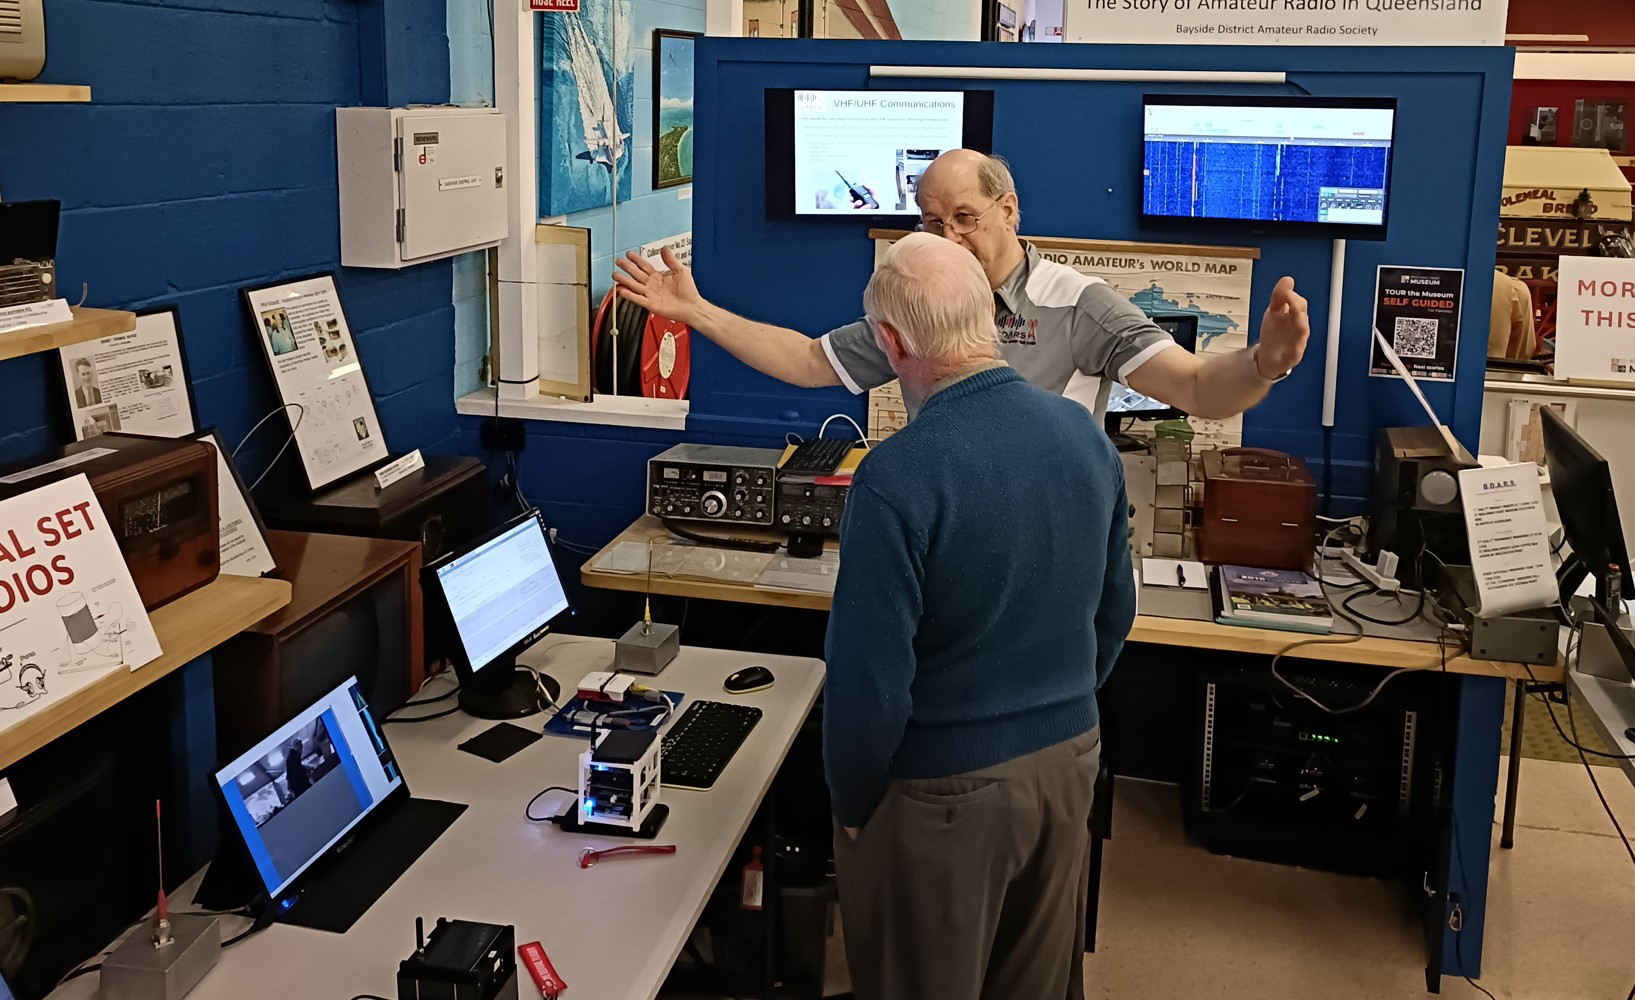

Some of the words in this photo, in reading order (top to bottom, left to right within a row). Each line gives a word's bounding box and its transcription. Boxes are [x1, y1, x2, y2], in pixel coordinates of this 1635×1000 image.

[1122, 0, 1165, 13] Story
[1174, 0, 1190, 10] of
[1197, 0, 1274, 10] Amateur
[1284, 0, 1336, 10] Radio
[1343, 0, 1359, 10] in
[1366, 0, 1482, 12] Queensland
[1176, 25, 1214, 35] Bayside
[1218, 25, 1254, 34] District
[1258, 26, 1303, 34] Amateur
[1306, 25, 1336, 34] Radio
[1339, 26, 1378, 36] Society
[880, 100, 955, 108] Communications
[1501, 189, 1557, 207] OLEMEAL
[1542, 203, 1598, 214] BRED
[1497, 226, 1614, 248] CLEVEL
[1038, 253, 1068, 264] DIO
[1072, 255, 1145, 270] AMATEUR's
[1150, 259, 1200, 272] WORLD
[1205, 263, 1237, 274] MAP
[1578, 280, 1635, 298] MOR
[1383, 297, 1409, 306] SELF
[1411, 299, 1454, 309] GUIDED
[1581, 310, 1635, 328] THIS
[1000, 331, 1026, 339] DARS
[1483, 480, 1517, 490] B.D.A.R.S.
[37, 501, 95, 546] SET
